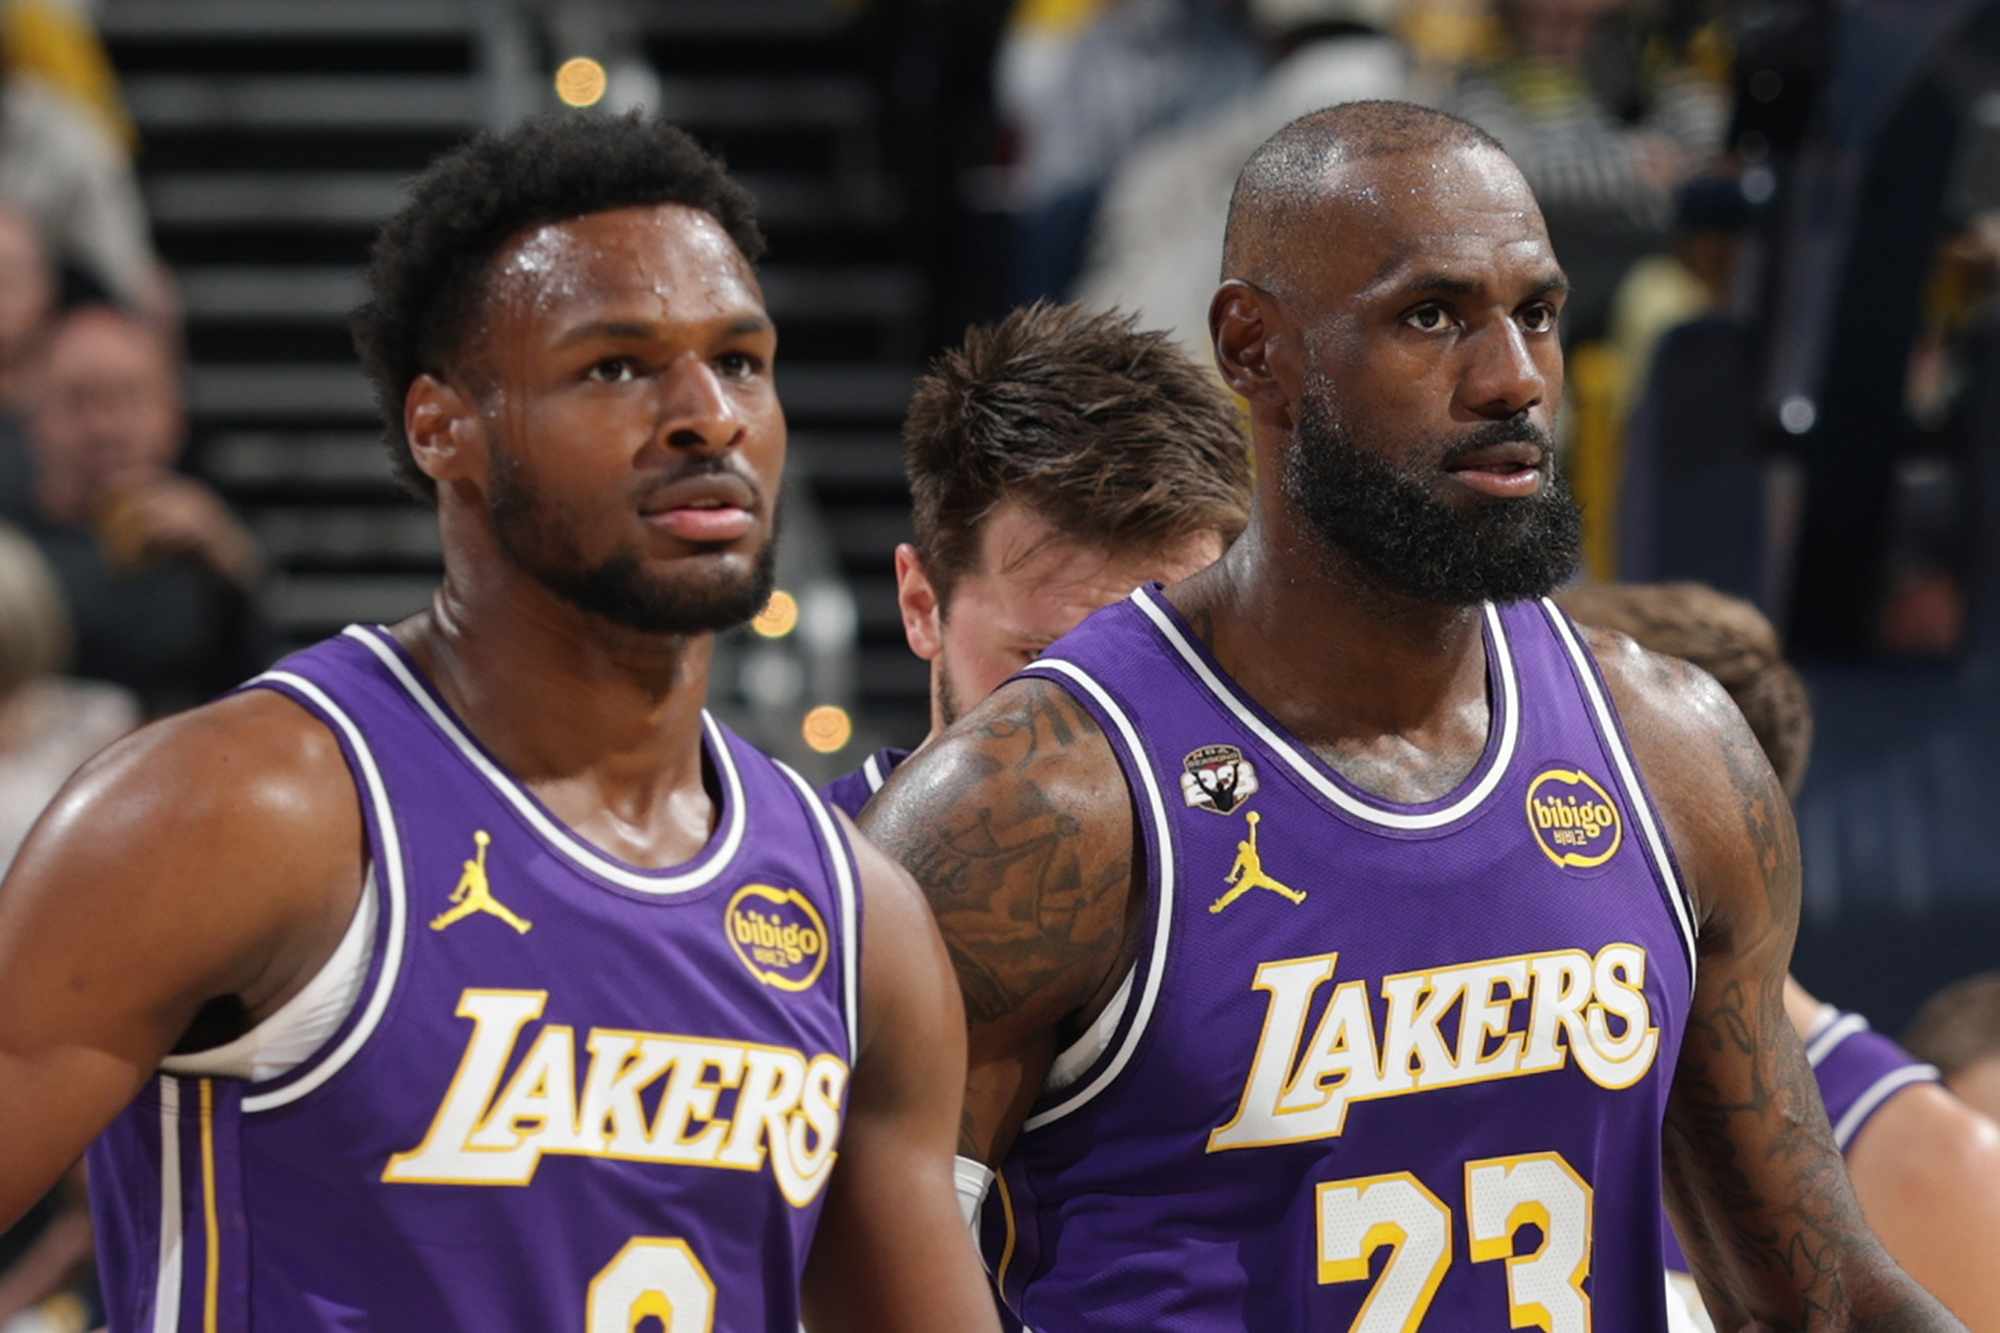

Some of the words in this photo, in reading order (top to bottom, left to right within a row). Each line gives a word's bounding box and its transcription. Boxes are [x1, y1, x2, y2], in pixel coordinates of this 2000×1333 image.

[1533, 795, 1613, 838] bibigo
[735, 910, 819, 964] bibigo
[381, 987, 849, 1208] LAKERS
[1205, 942, 1660, 1154] LAKERS
[1315, 1151, 1594, 1333] 23
